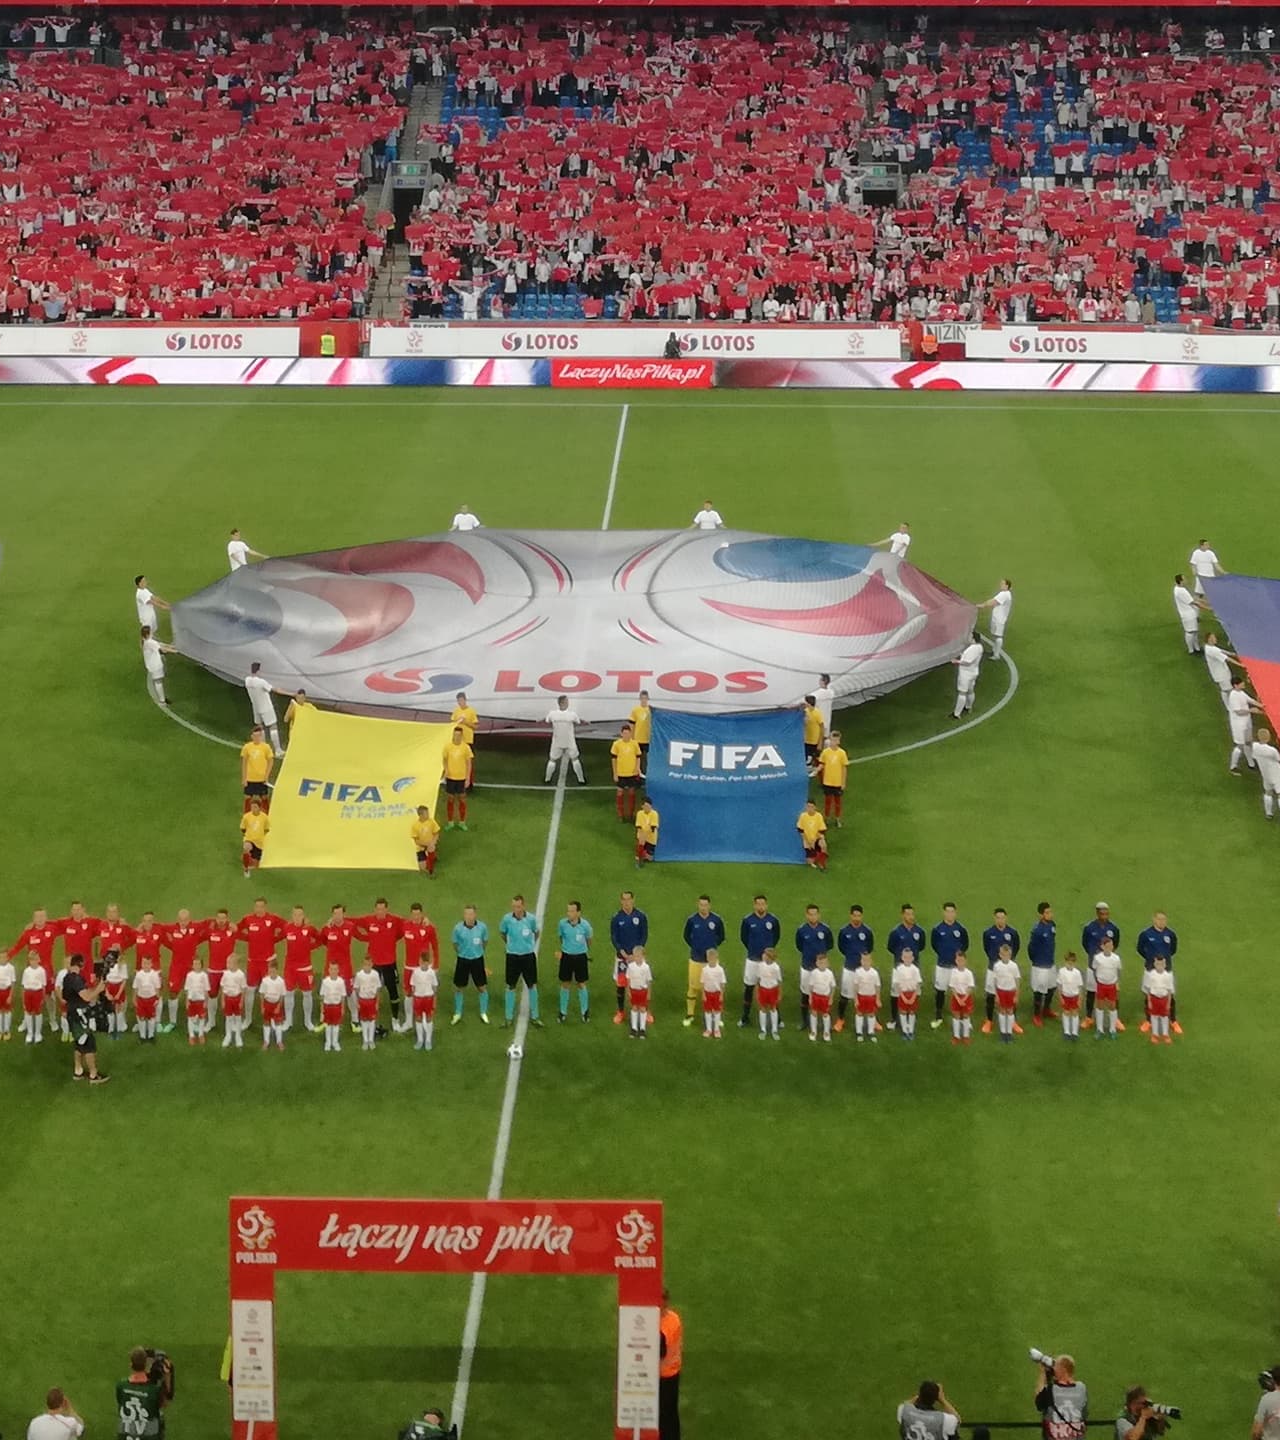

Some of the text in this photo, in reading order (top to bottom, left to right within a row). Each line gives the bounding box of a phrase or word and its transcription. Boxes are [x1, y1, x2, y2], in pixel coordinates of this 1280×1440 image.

[190, 333, 243, 350] LOTOS
[526, 333, 579, 350] LOTOS
[702, 335, 755, 351] LOTOS
[1035, 337, 1087, 353] LOTOS
[493, 669, 769, 694] LOTOS
[669, 741, 786, 770] FIFA
[298, 778, 382, 803] FIFA
[318, 1213, 574, 1265] Łączy nas piłka
[236, 1252, 277, 1264] POLSKA
[615, 1256, 656, 1268] POLSKA
